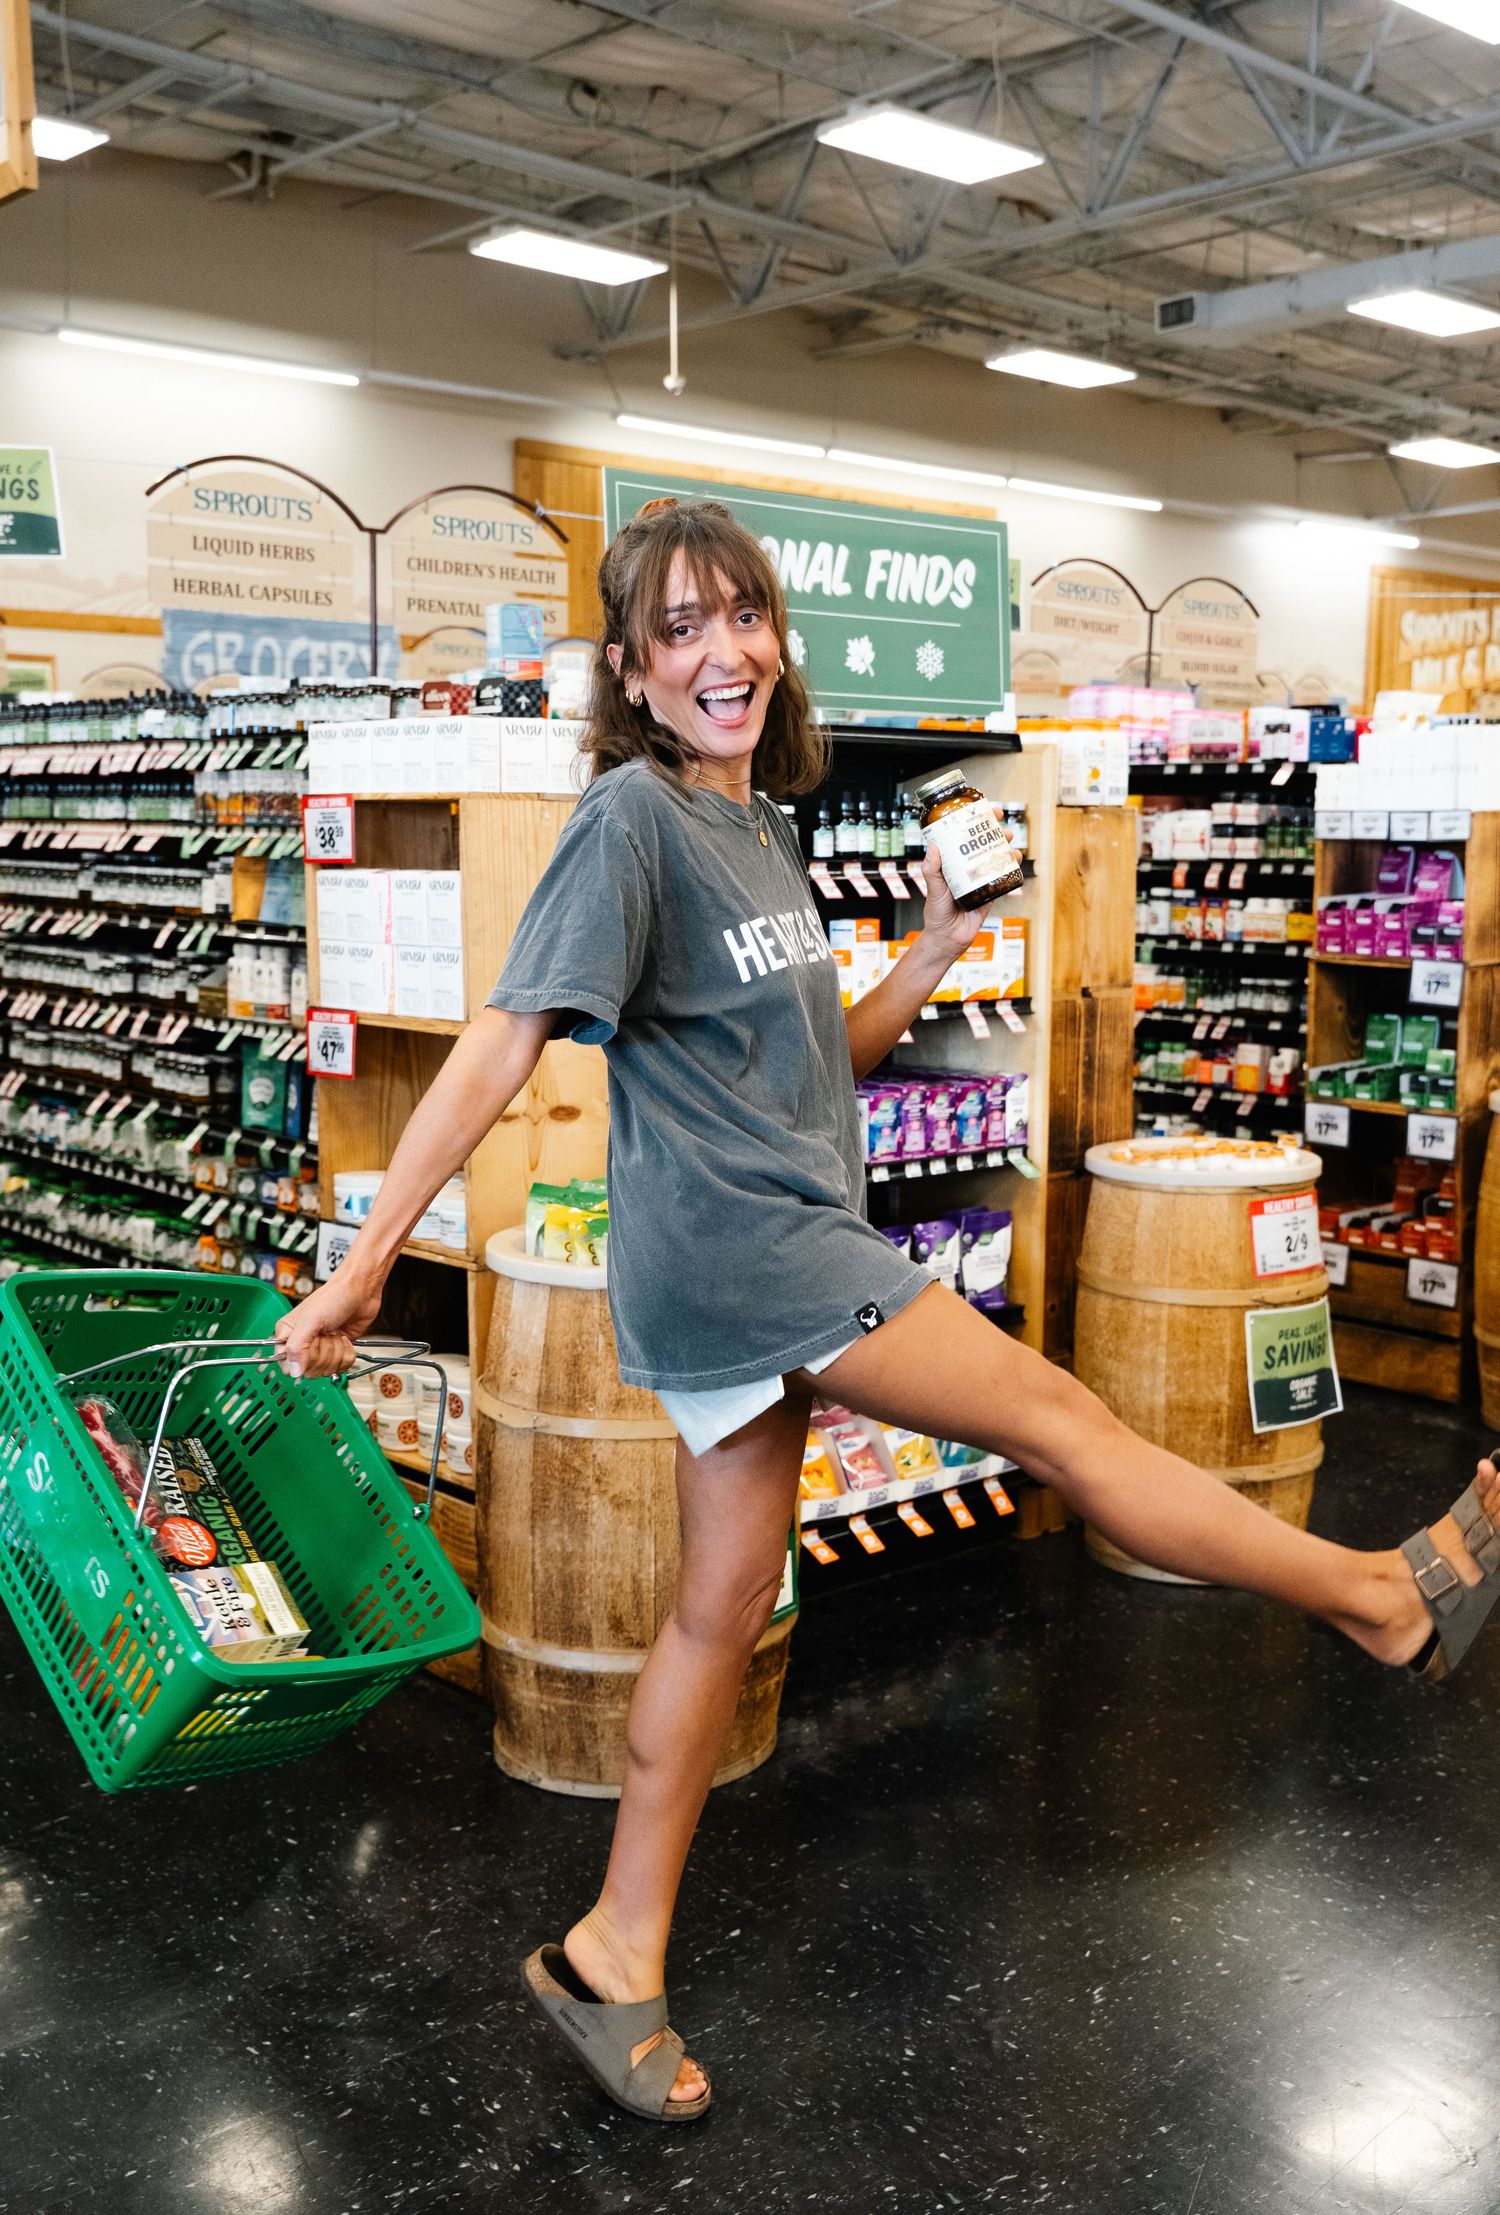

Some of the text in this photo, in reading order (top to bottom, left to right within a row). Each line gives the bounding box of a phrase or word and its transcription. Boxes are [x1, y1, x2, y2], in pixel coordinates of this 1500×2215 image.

[194, 487, 313, 522] SPROUTS
[432, 514, 533, 545] SPROUTS
[192, 535, 316, 563] LIQUID HERBS
[406, 556, 557, 586] CHILDREN'S HEALTH
[865, 549, 976, 610] FINDS
[173, 577, 333, 607] HERBAL CAPSULES
[1056, 581, 1121, 607] SPROUTS
[406, 597, 484, 619] PRENATAL
[1182, 600, 1240, 621] SPROUTS
[1180, 660, 1209, 673] BLOOD
[959, 827, 1004, 856] ORGANS
[968, 819, 991, 837] BEEF
[1264, 1331, 1327, 1370] SAVINGS
[149, 1446, 190, 1516] RAISED
[164, 1522, 209, 1565] Vital
[205, 1579, 238, 1630] Kettle
[221, 1577, 251, 1628] & Fire
